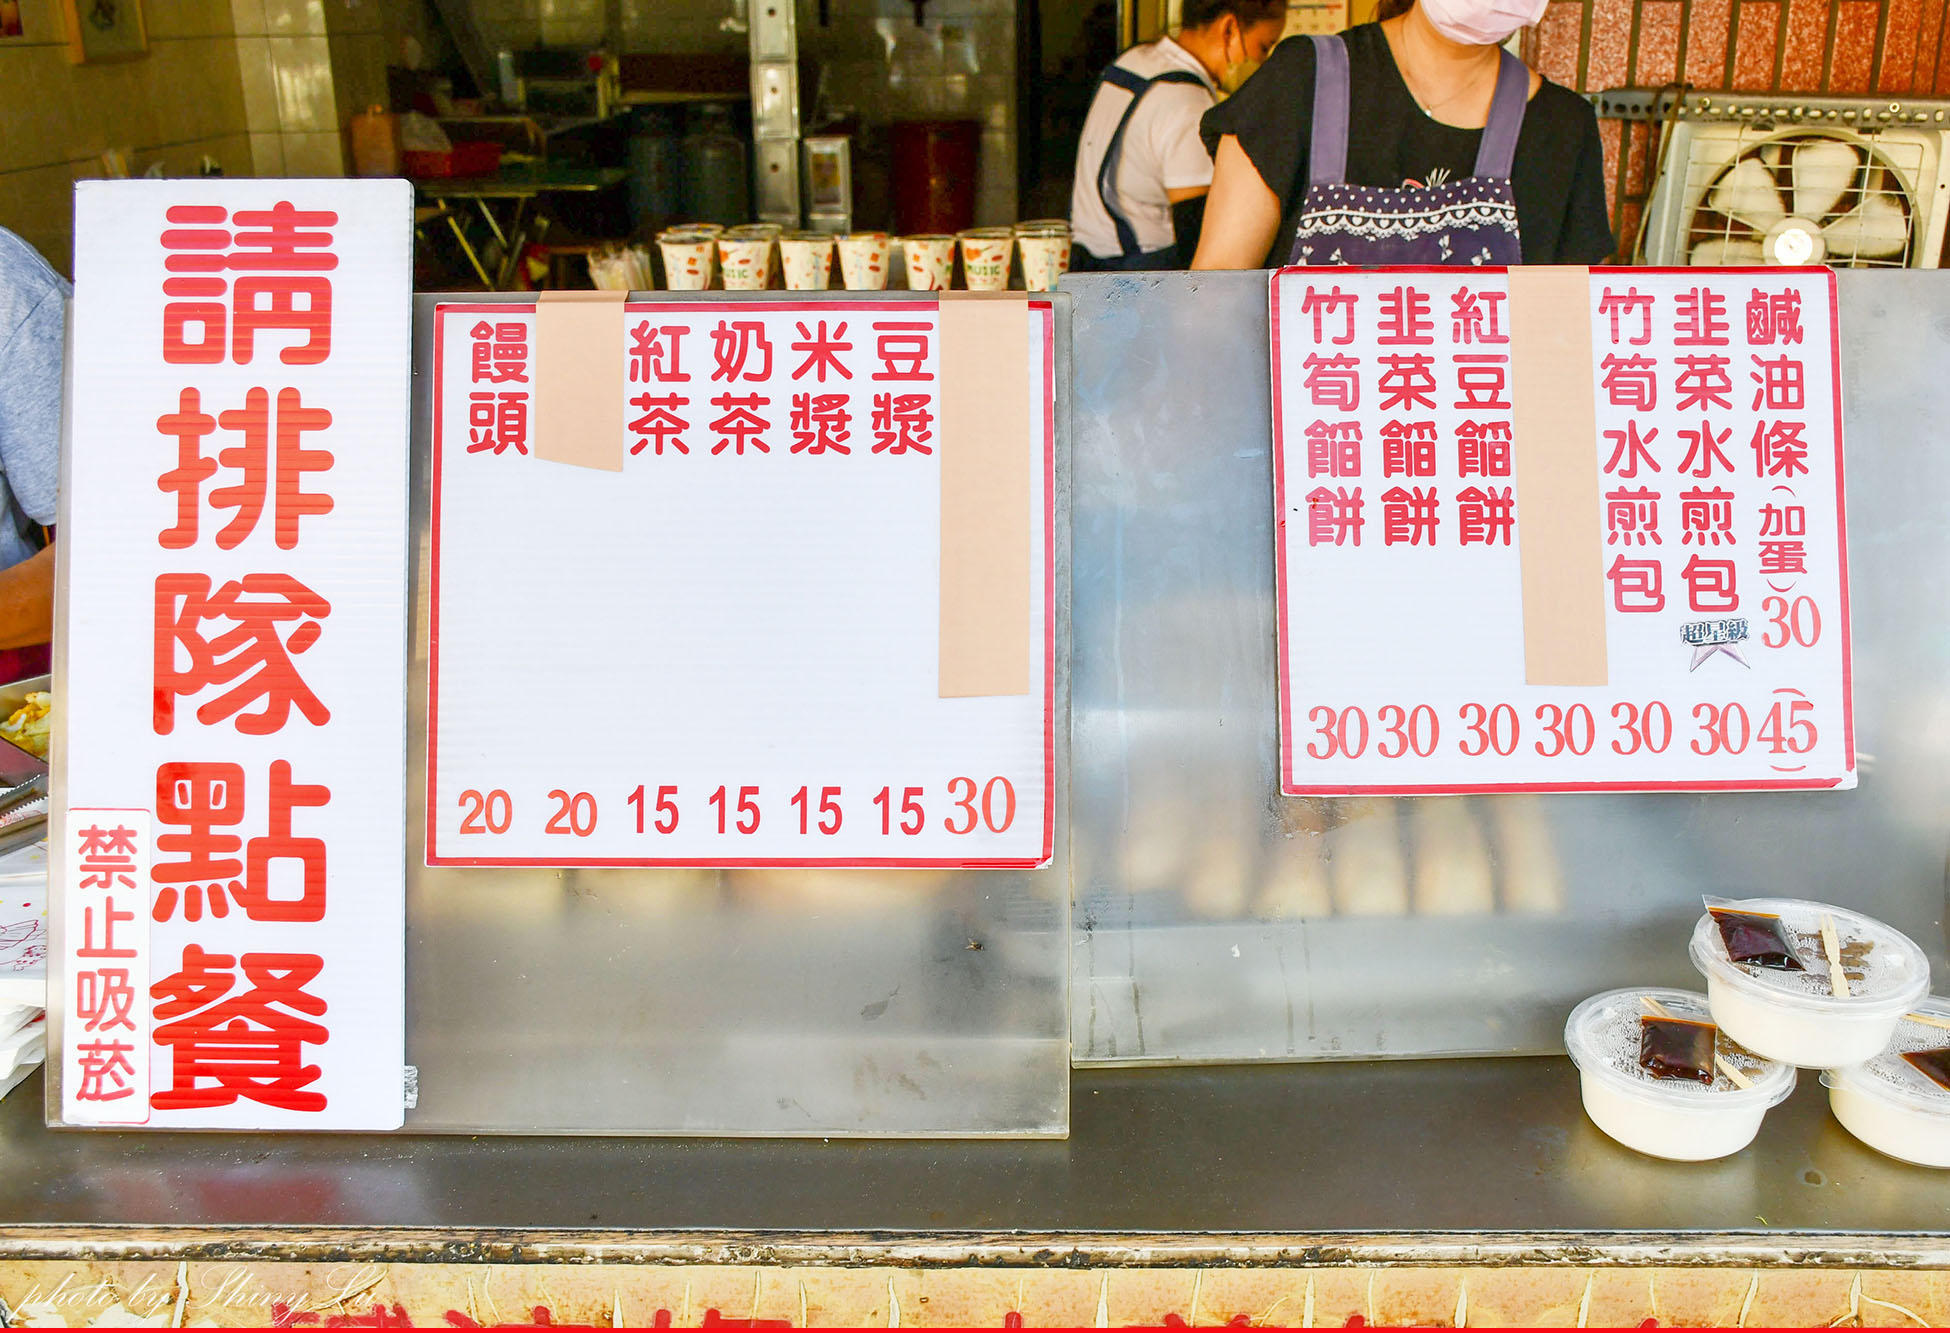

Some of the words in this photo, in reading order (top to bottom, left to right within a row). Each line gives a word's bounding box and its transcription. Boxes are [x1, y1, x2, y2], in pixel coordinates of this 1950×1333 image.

[466, 320, 530, 456] 饅頭
[627, 319, 692, 456] 紅茶
[708, 319, 773, 456] 奶茶
[789, 319, 854, 456] 米漿
[871, 321, 935, 456] 豆漿
[1301, 285, 1366, 547] 竹筍餡餅
[1377, 286, 1441, 547] 韭菜餡餅
[1450, 286, 1516, 547] 紅豆餡餅
[1598, 286, 1666, 613] 竹筍水煎包
[1673, 287, 1740, 613] 韭菜水煎包
[150, 200, 340, 1113] 請排隊點餐
[1680, 618, 1751, 647] 超星級
[1761, 595, 1822, 649] 30
[1307, 705, 1369, 760] 30
[1377, 703, 1440, 759] 30
[1458, 702, 1521, 757] 30
[1535, 703, 1596, 758] 30
[1610, 700, 1673, 756] 30
[1690, 702, 1751, 756] 30
[457, 788, 513, 835] 20
[544, 789, 598, 838] 20
[627, 784, 680, 835] 15
[708, 784, 761, 835] 15
[790, 785, 843, 836] 15
[872, 785, 926, 836] 15
[943, 775, 1017, 835] 30
[76, 824, 138, 1102] 禁止吸菸
